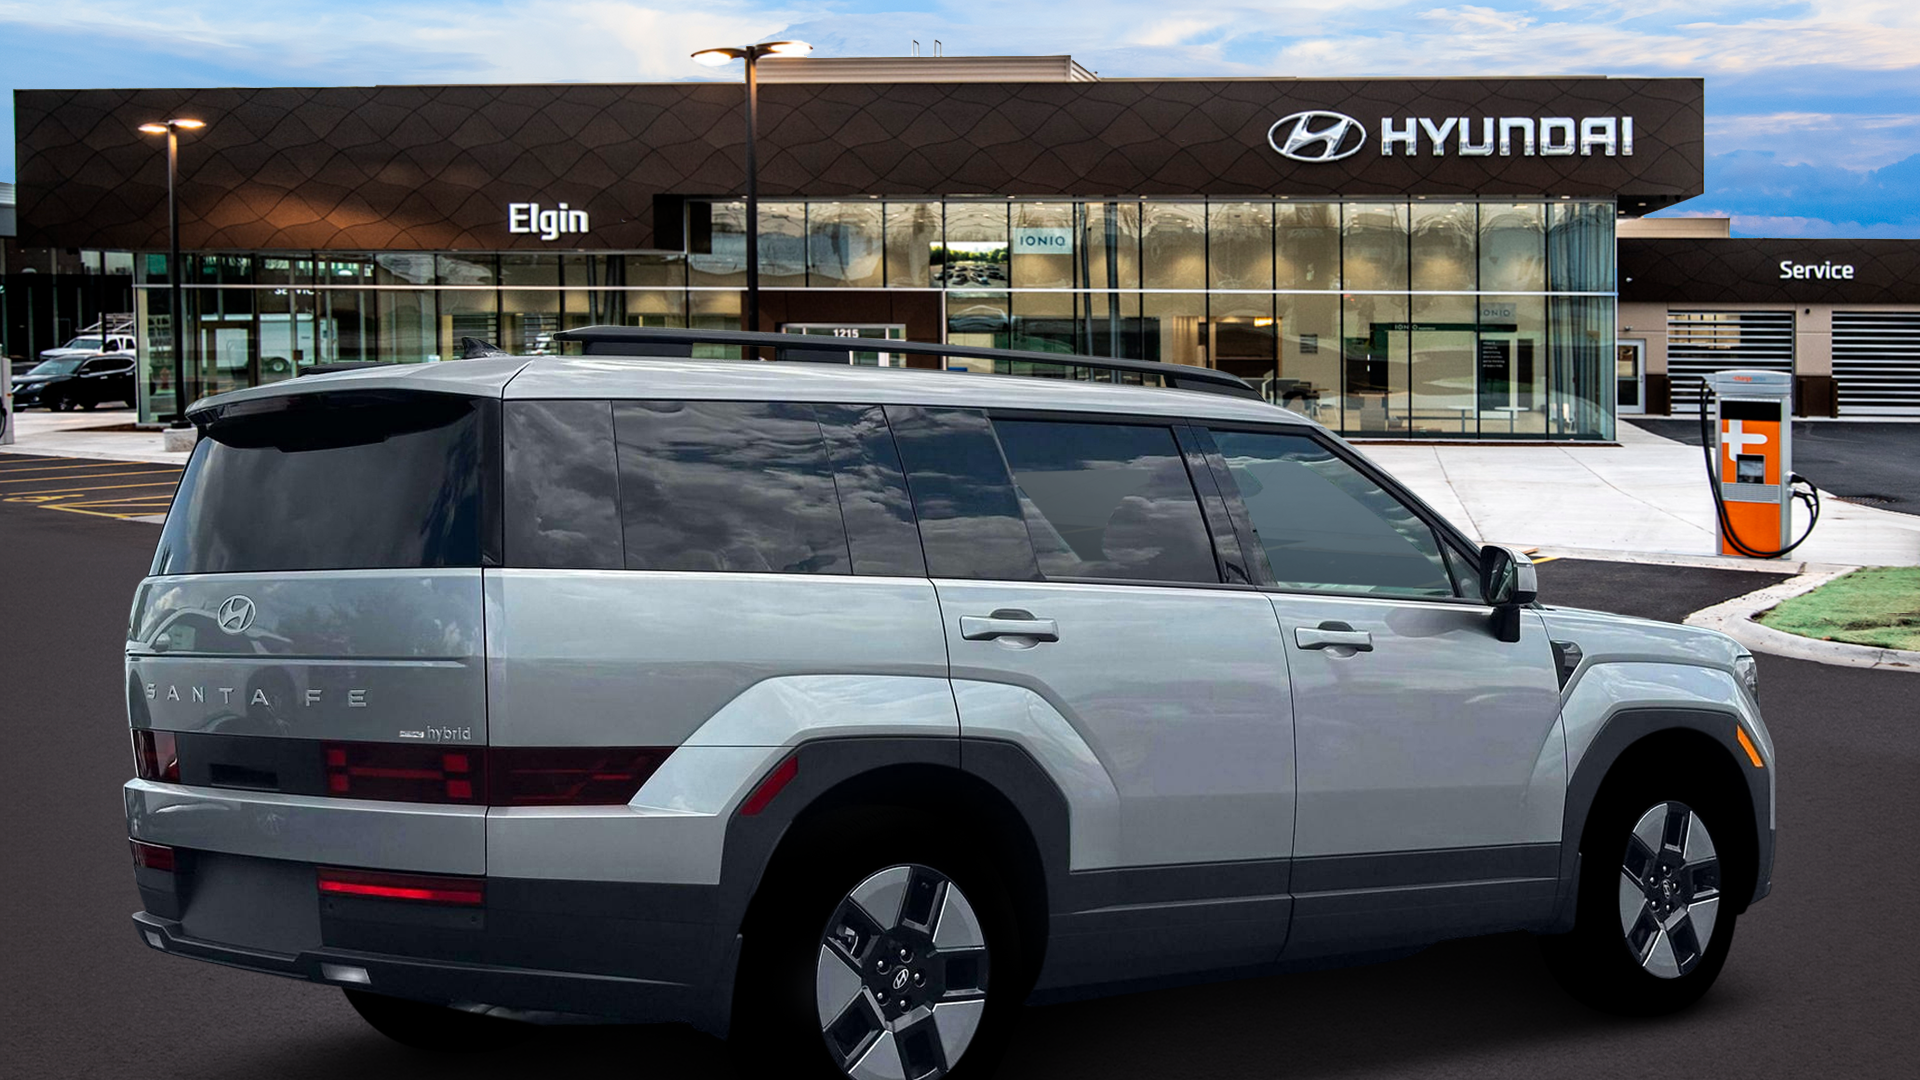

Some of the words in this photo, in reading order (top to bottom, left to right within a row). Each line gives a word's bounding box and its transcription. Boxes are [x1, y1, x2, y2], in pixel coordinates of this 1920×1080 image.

[1381, 117, 1633, 157] HYUNDAI
[508, 202, 590, 240] Elgin
[1020, 235, 1066, 247] IONIQ
[1779, 260, 1855, 279] Service
[833, 328, 859, 338] 1215
[146, 683, 269, 706] SANTA
[305, 689, 367, 707] FE
[427, 725, 471, 742] hybrid
